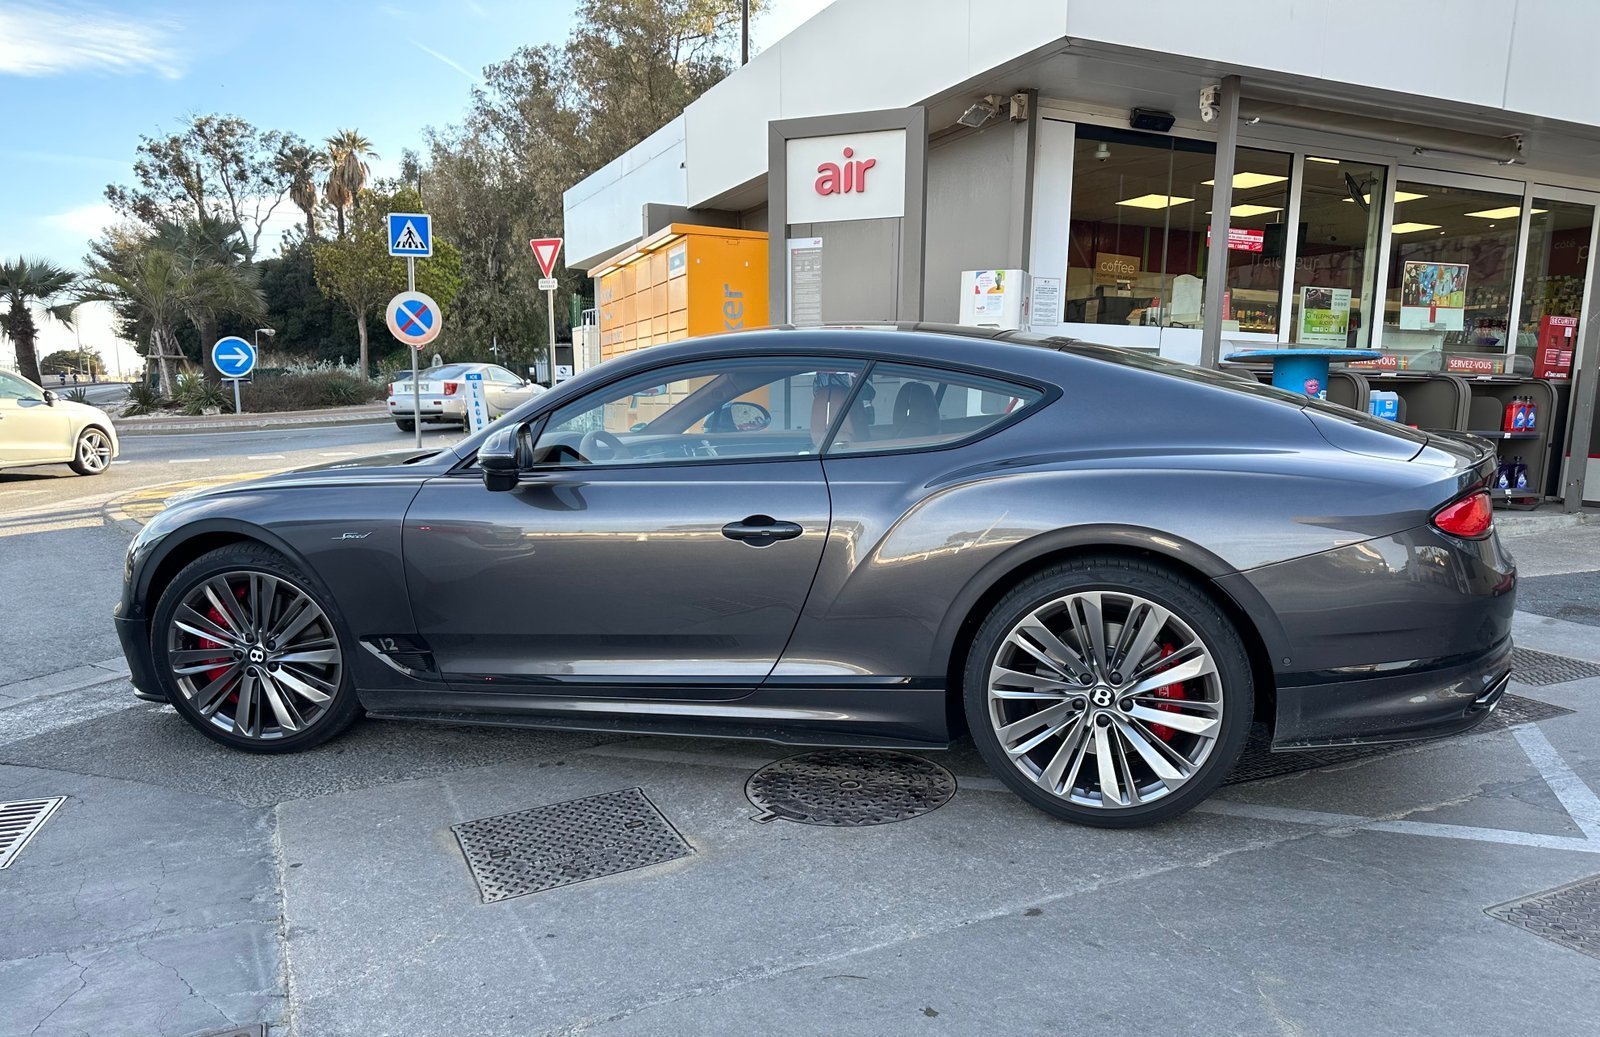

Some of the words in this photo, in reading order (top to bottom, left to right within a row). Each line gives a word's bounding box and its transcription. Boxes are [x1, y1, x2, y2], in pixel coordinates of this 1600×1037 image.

[815, 147, 876, 196] air
[1101, 260, 1135, 273] coffee
[1450, 359, 1492, 369] SERVEZ-VOUS
